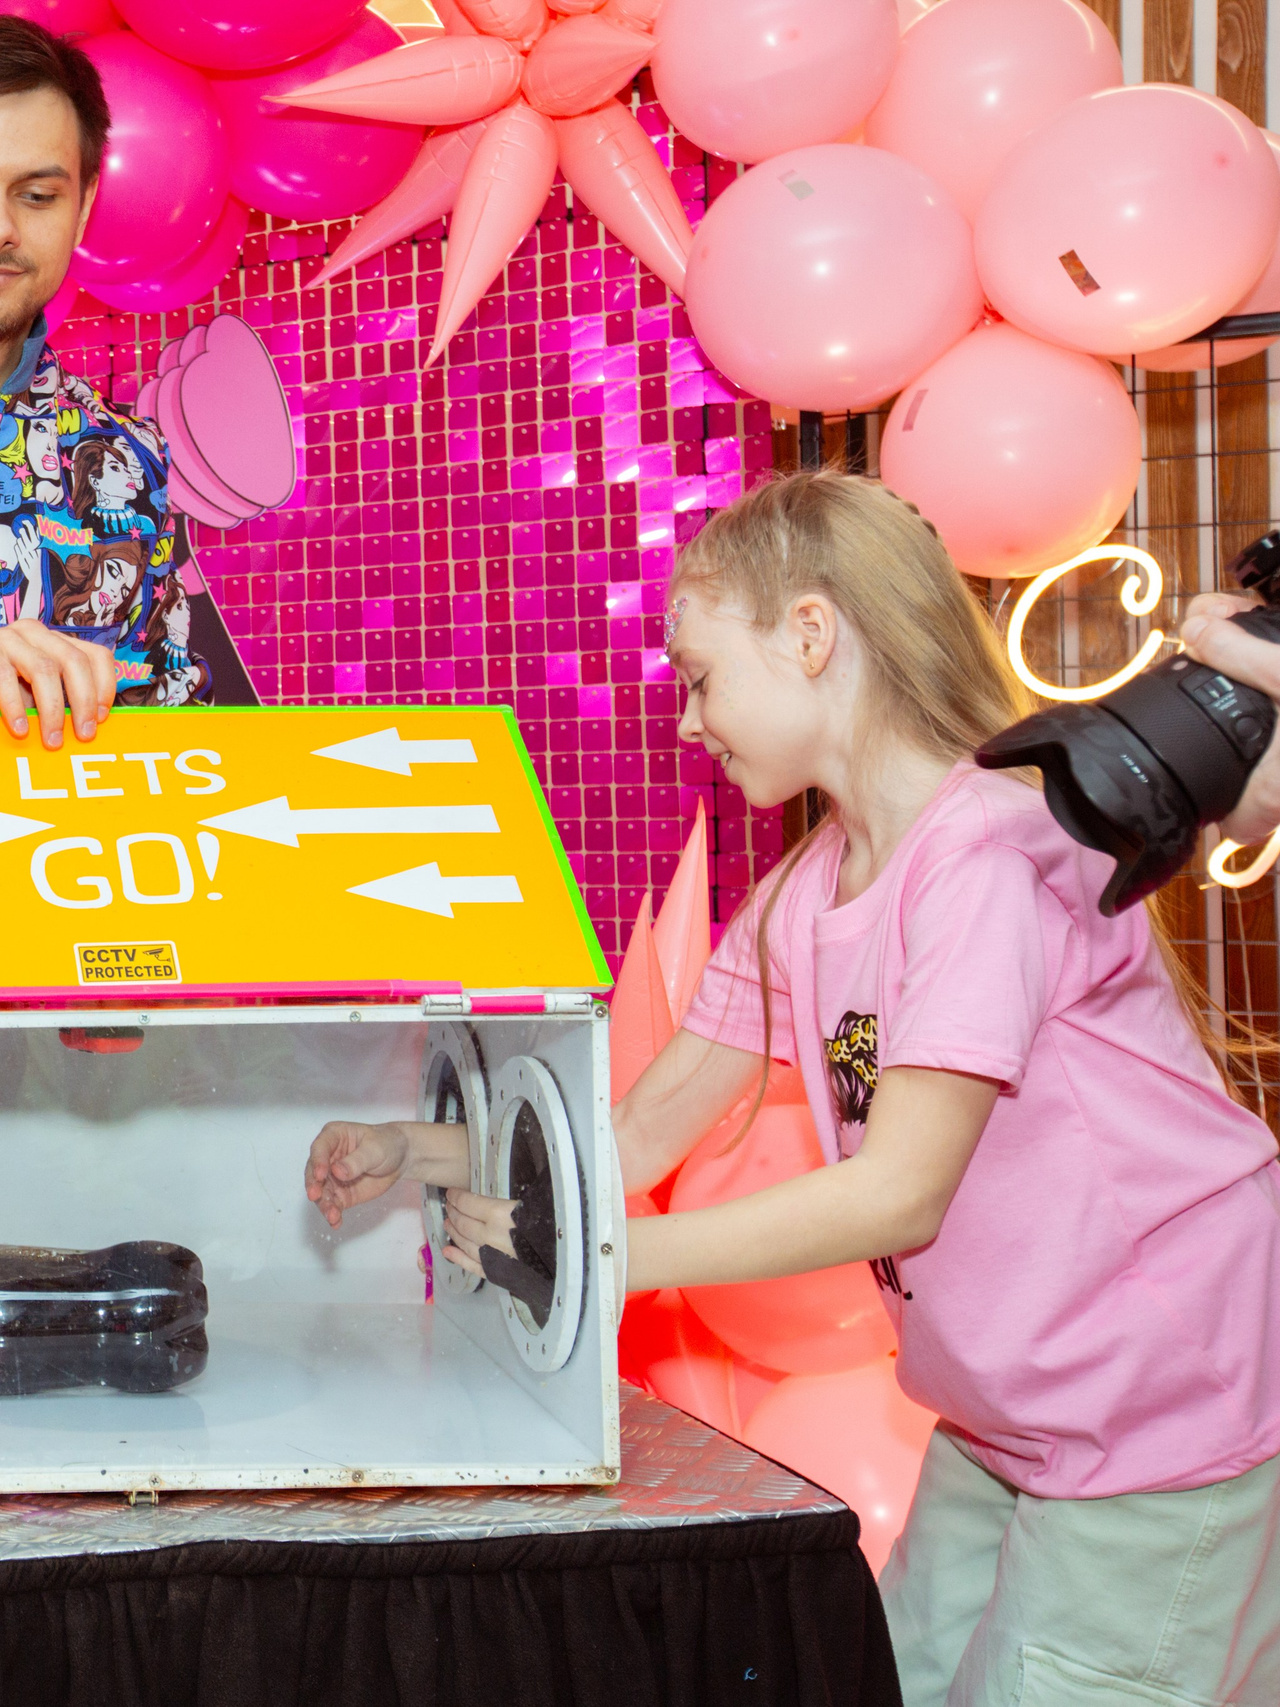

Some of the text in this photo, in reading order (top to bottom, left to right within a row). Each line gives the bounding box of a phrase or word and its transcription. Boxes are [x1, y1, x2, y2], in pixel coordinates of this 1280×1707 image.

[36, 514, 94, 546] WOW!
[114, 660, 154, 681] OW!
[16, 748, 227, 800] LETS
[30, 831, 223, 909] GO!
[83, 948, 136, 963] CCTV
[84, 965, 173, 979] PROTECTED
